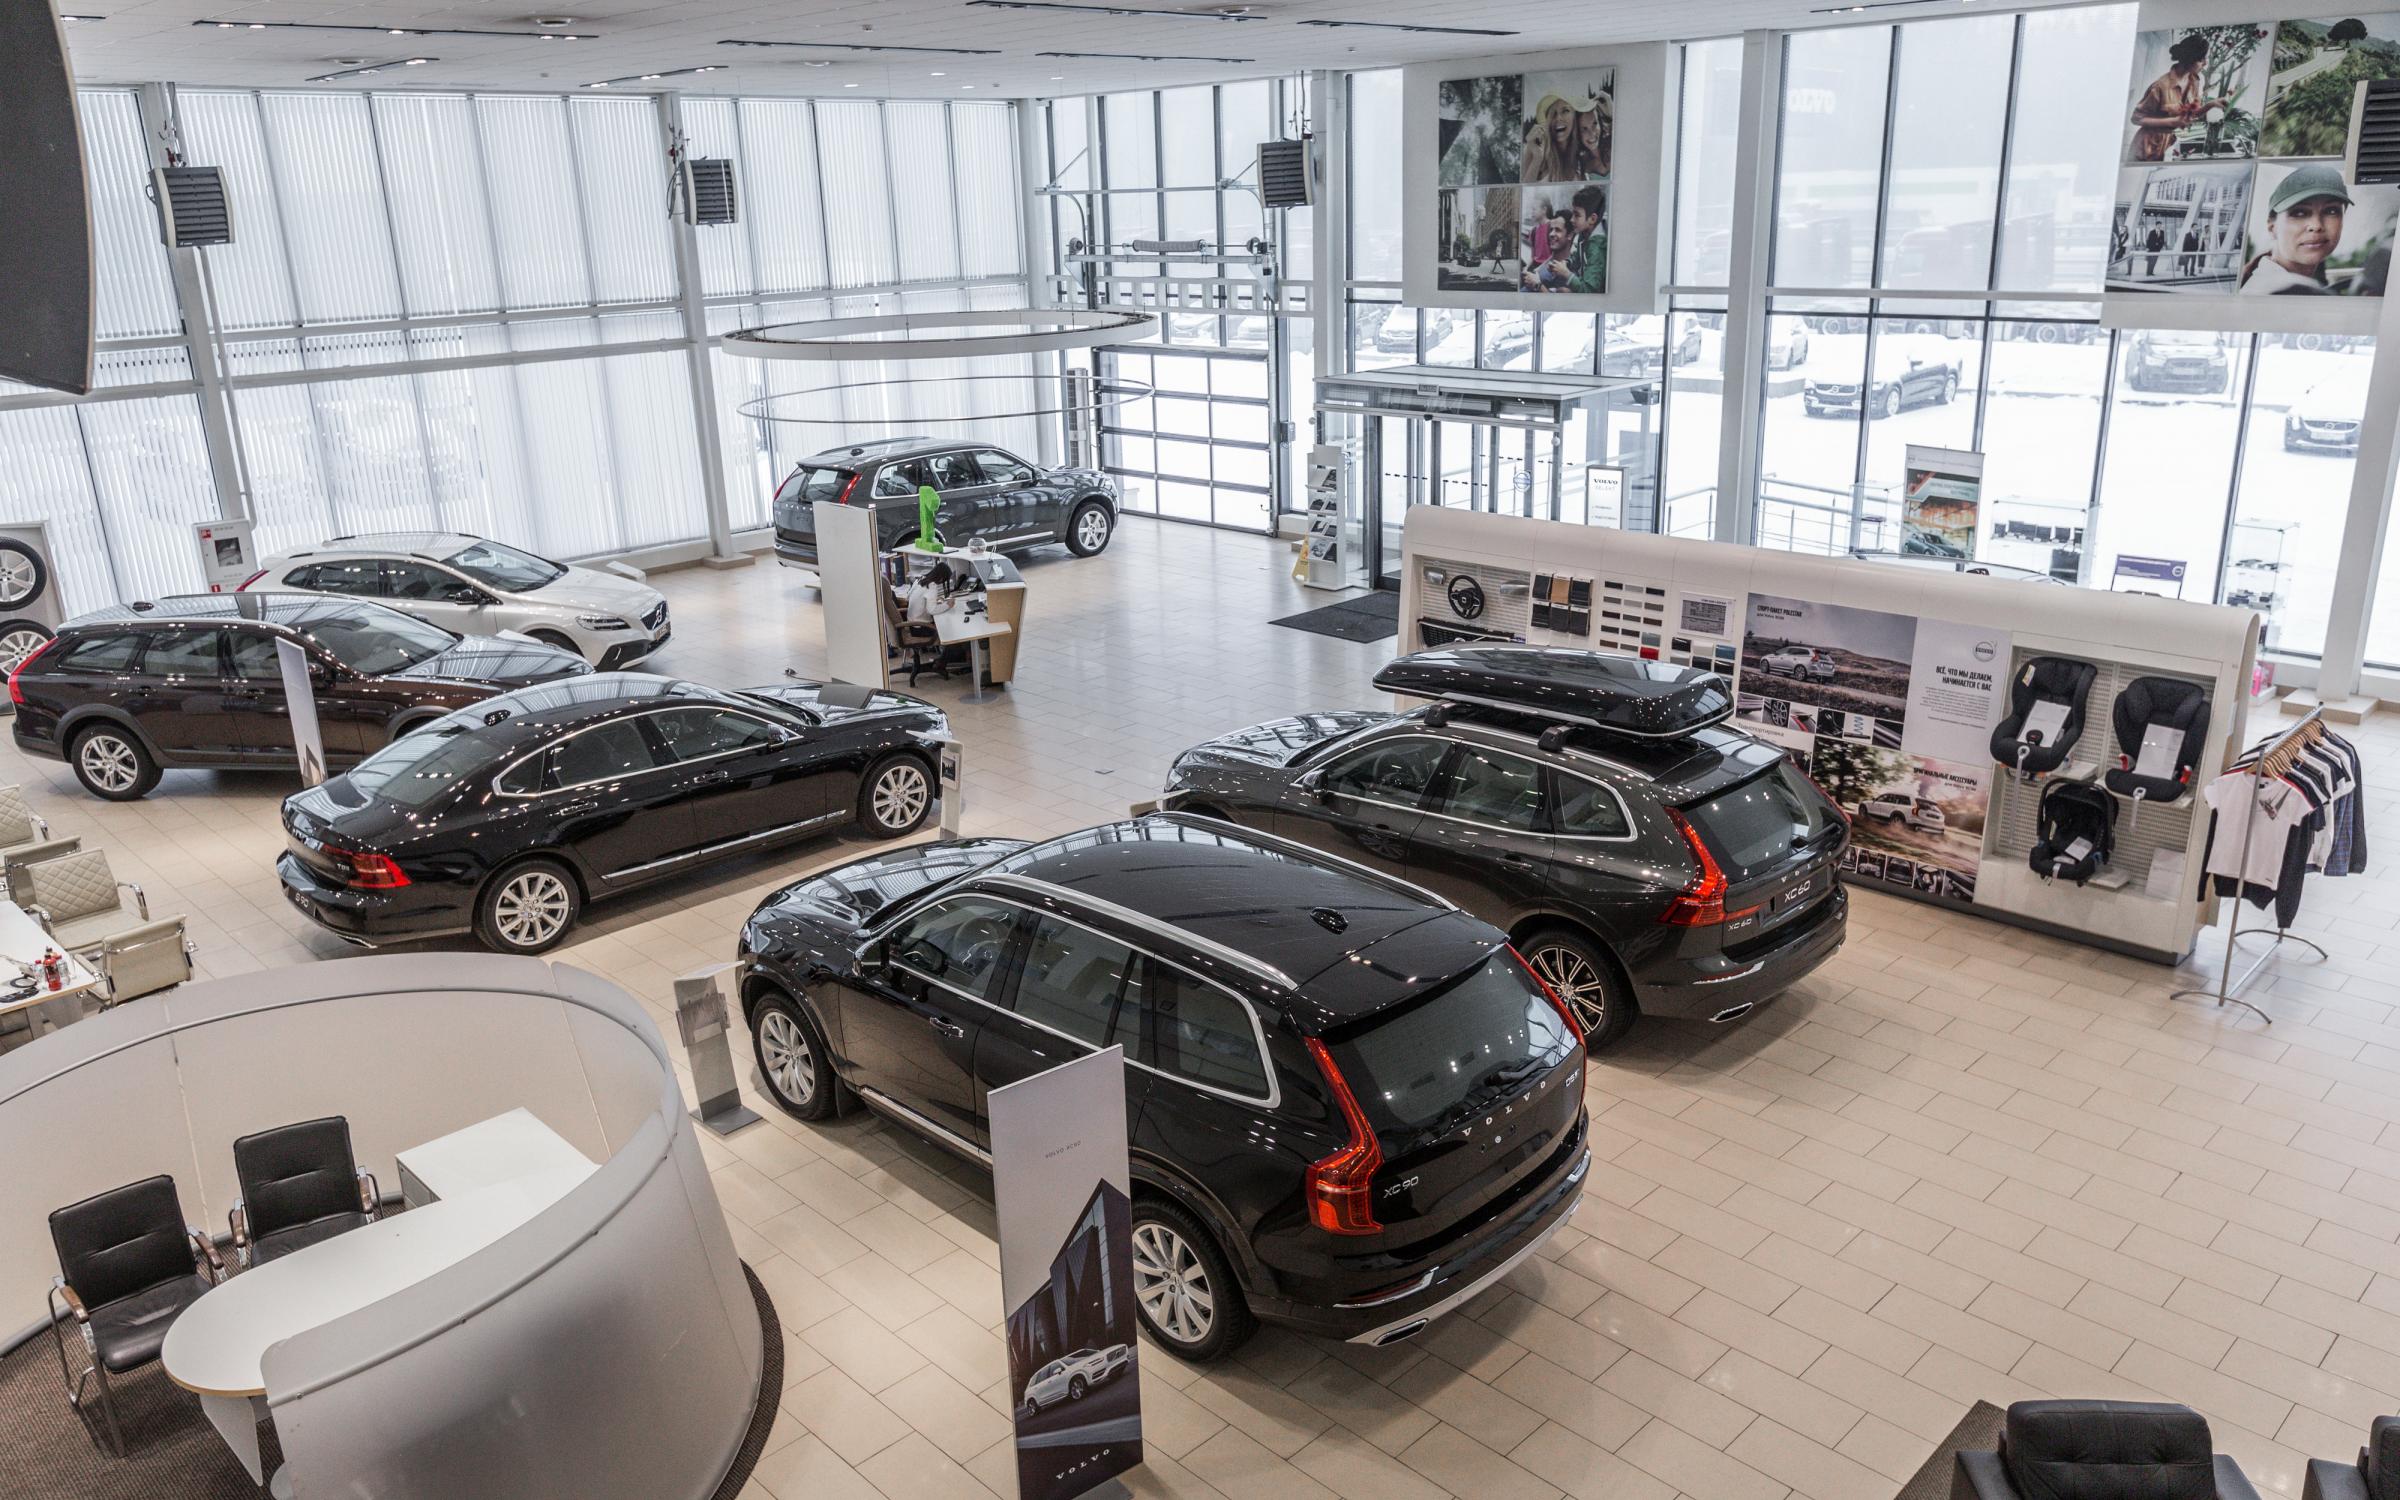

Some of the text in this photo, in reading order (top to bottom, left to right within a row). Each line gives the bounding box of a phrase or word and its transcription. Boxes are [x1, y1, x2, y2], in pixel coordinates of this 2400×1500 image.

[1942, 677, 1992, 691] НАЧИНАЕТСЯ С ВАС
[1947, 668, 1958, 676] ЧТО
[1959, 670, 1969, 678] МЫ
[1781, 851, 1832, 883] VOLVO
[295, 893, 309, 908] S90
[1784, 880, 1811, 903] XC60
[1728, 918, 1752, 931] XC60
[1462, 1081, 1546, 1137] VOLVO
[1383, 1176, 1419, 1199] XC90
[1056, 1448, 1110, 1480] VOLVO
